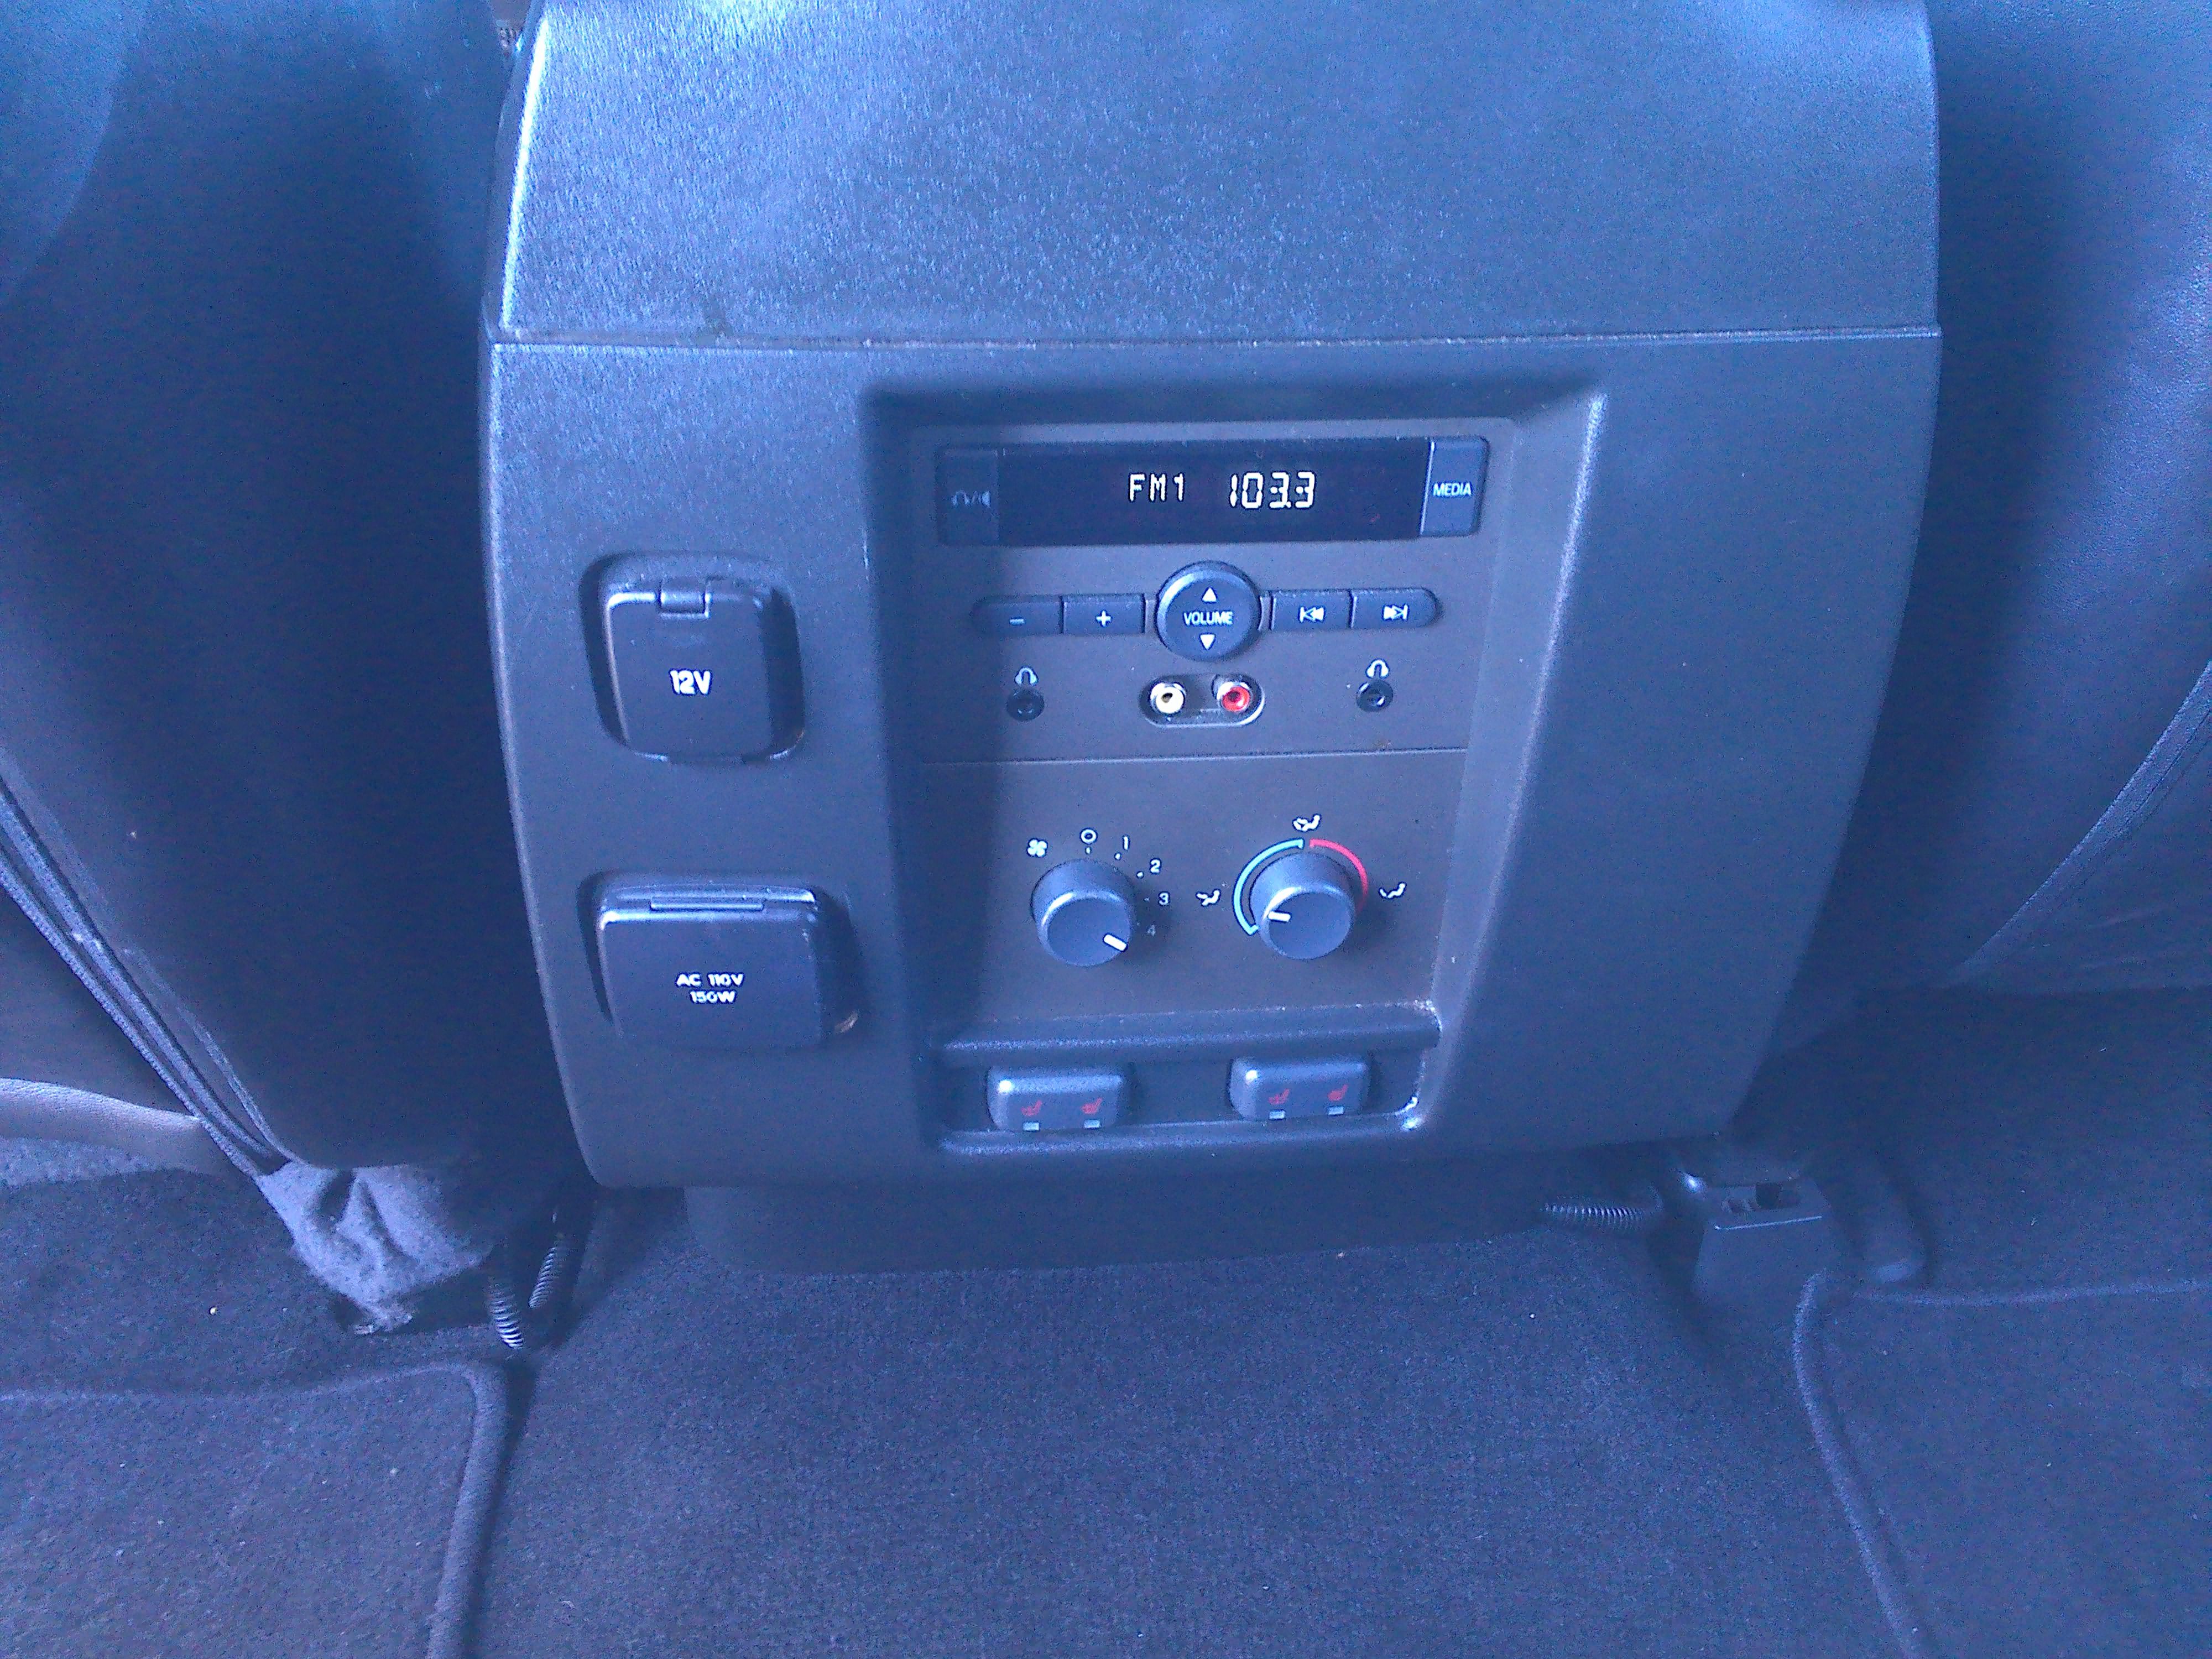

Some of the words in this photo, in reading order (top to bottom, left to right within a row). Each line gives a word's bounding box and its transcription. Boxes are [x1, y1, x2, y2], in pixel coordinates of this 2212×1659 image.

[1432, 482, 1473, 498] MEDIA
[1182, 610, 1233, 626] VOLUME
[670, 670, 711, 695] 12V
[1150, 858, 1162, 874] 2
[1158, 892, 1170, 906] 3
[1146, 925, 1156, 937] 4
[675, 973, 703, 987] AC
[707, 973, 745, 987] 110V
[690, 990, 737, 1004] 150W
